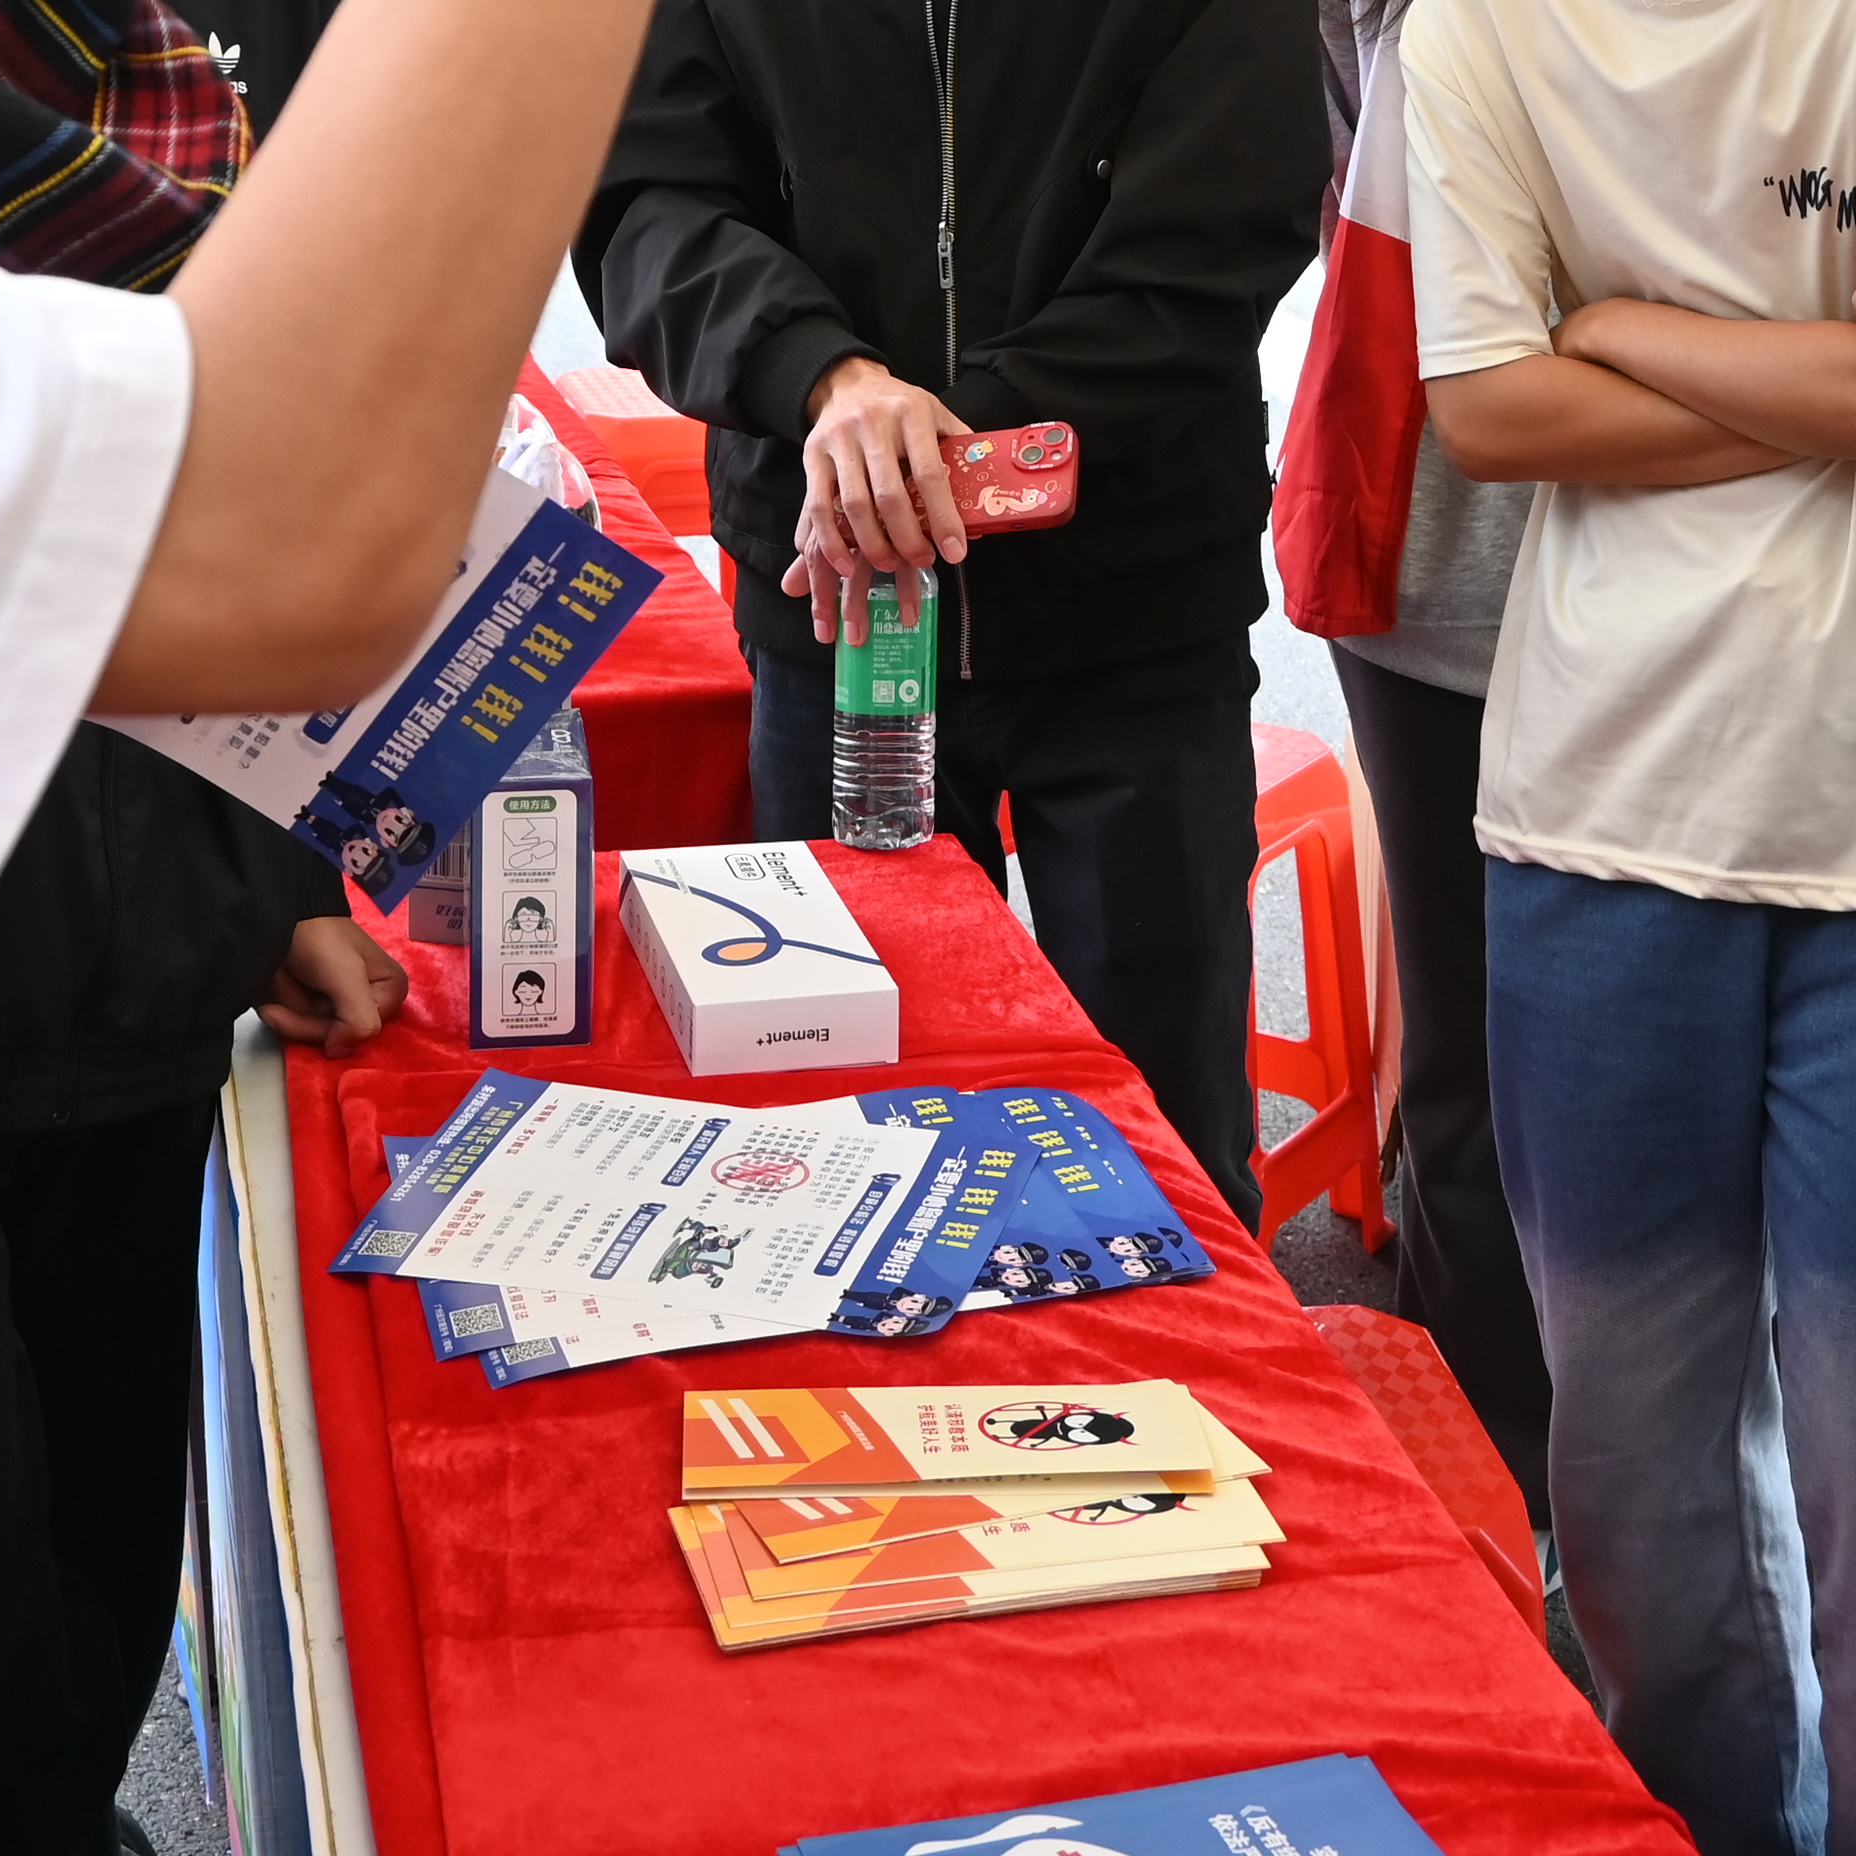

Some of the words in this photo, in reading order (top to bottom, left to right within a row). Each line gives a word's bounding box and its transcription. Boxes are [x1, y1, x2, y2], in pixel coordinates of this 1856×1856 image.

[369, 541, 567, 783] 一定要小心您账户里的钱！
[508, 798, 551, 811] 使用方法
[430, 1100, 526, 1194] 广州市反诈中心提醒您
[875, 1145, 968, 1284] 一定要小心您账户里的钱！
[943, 1402, 969, 1454] 认清邪教本质
